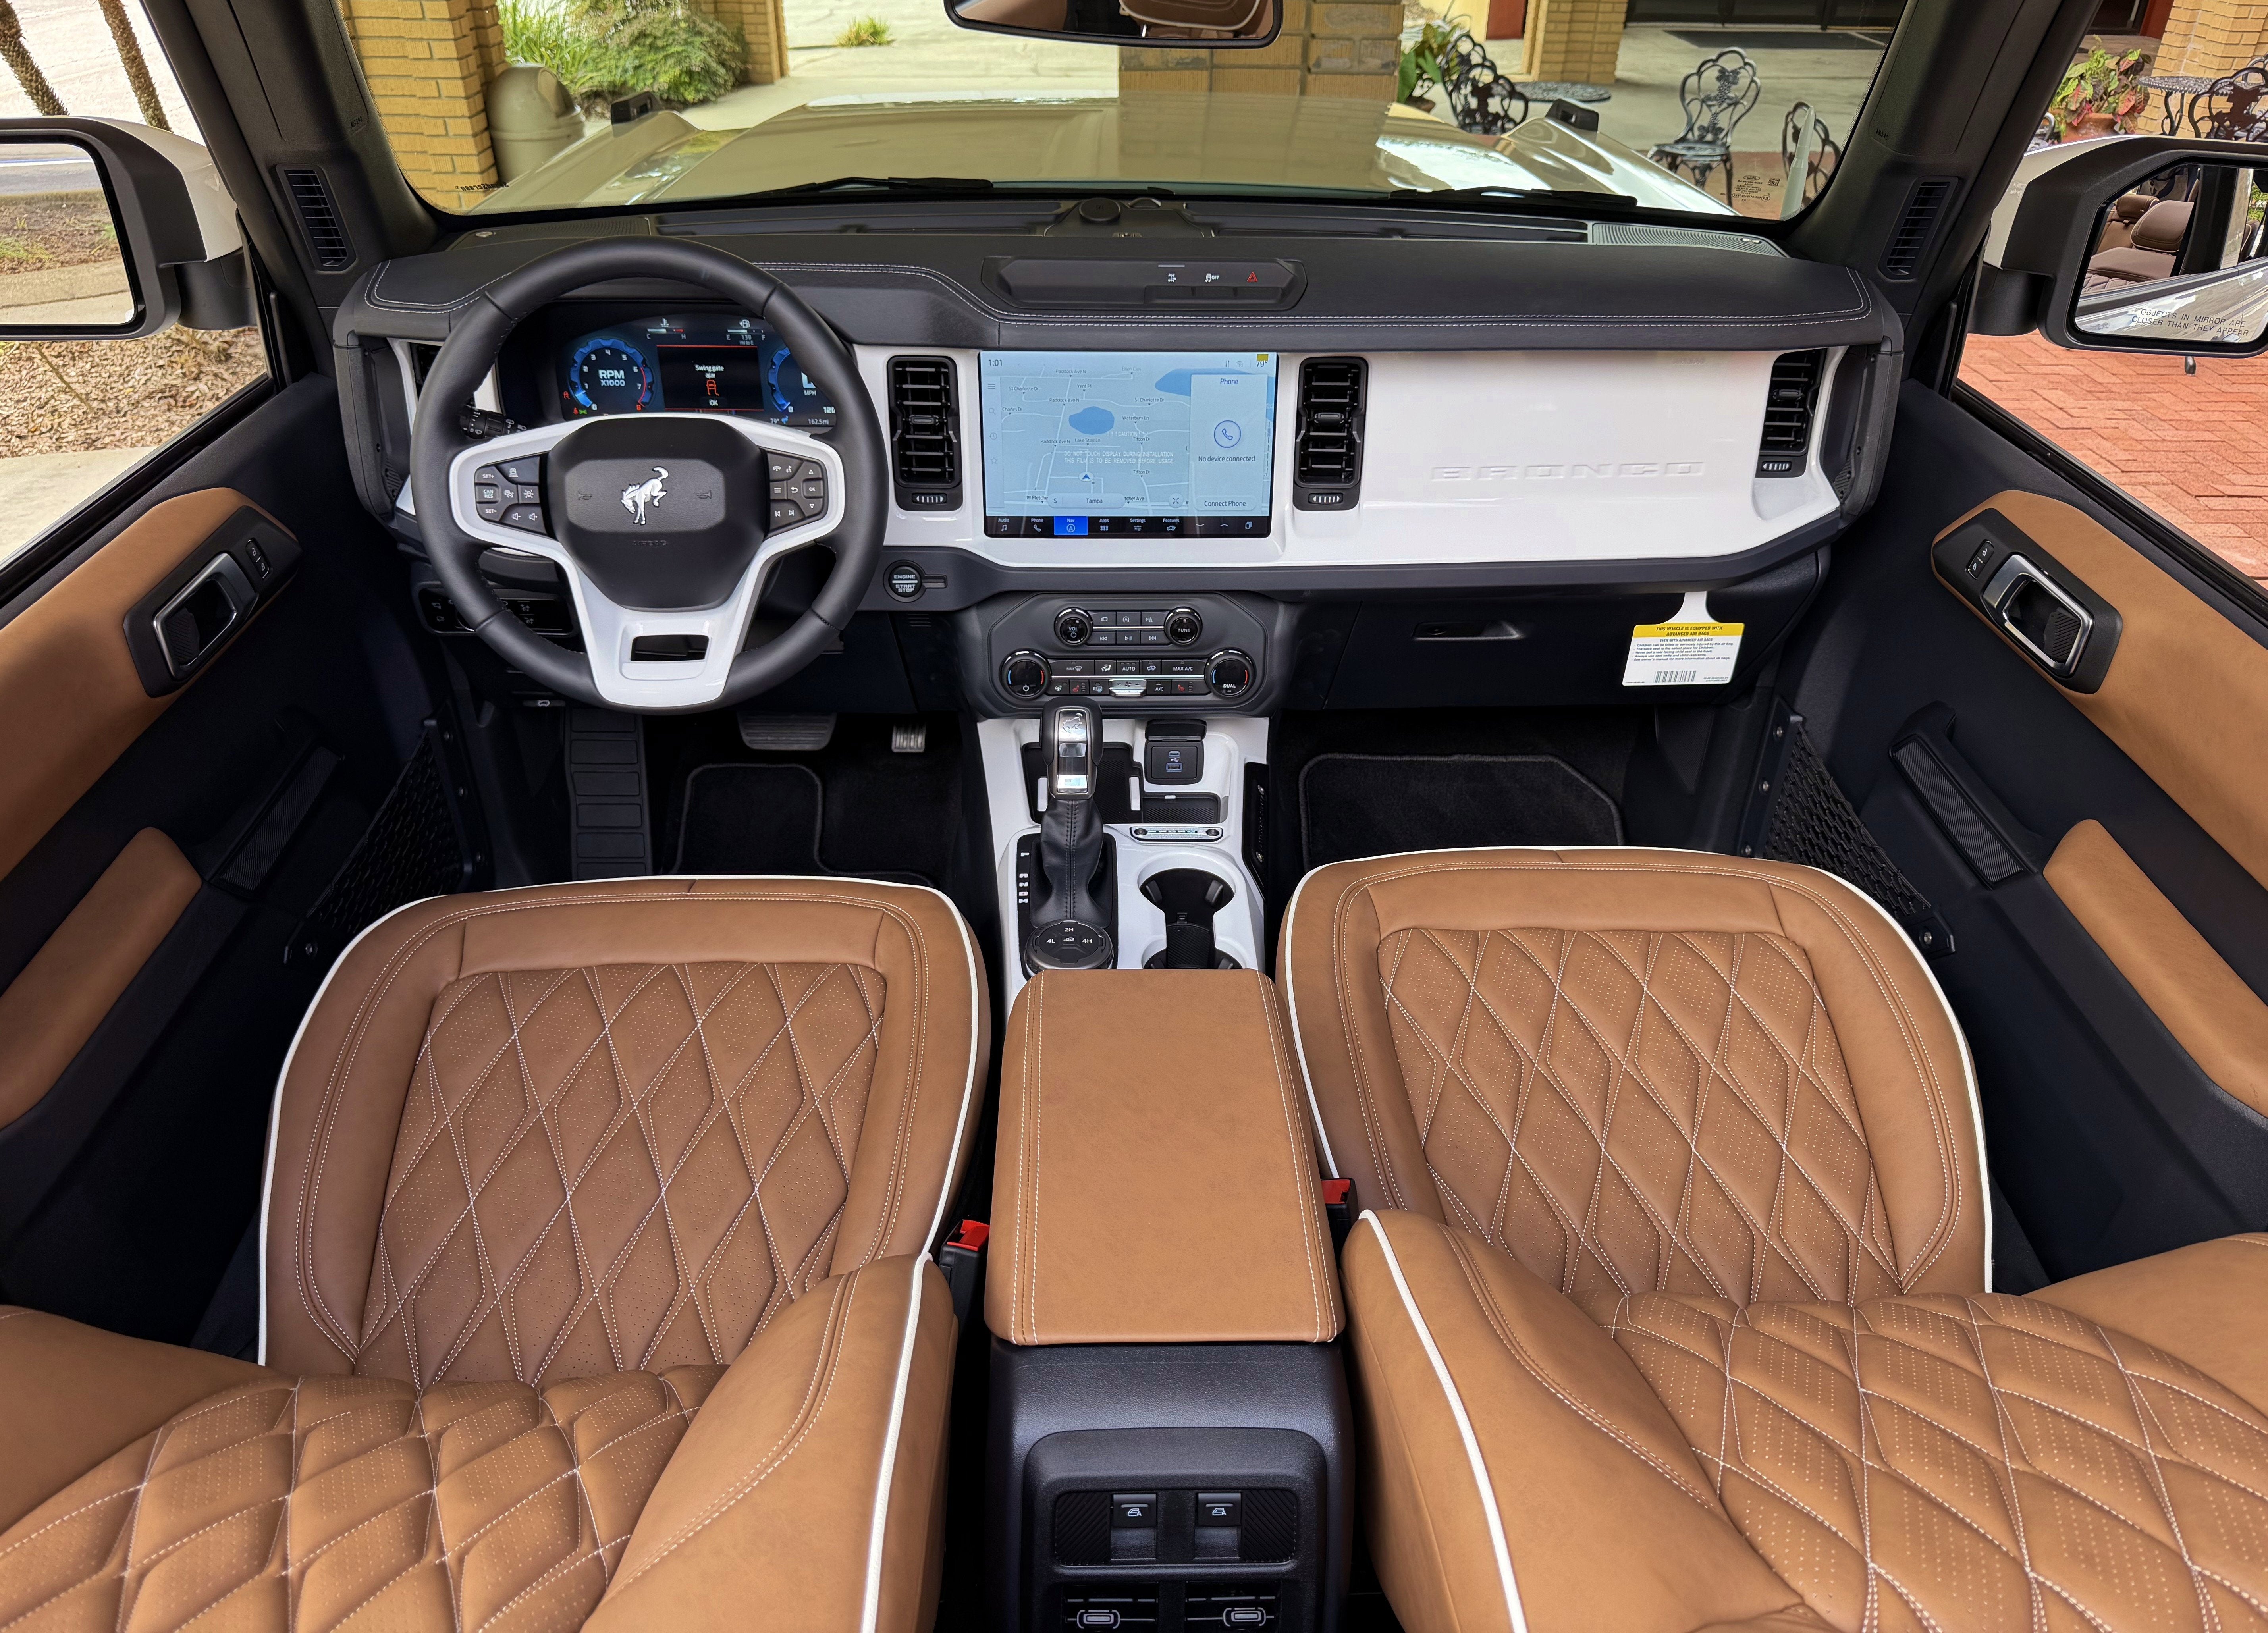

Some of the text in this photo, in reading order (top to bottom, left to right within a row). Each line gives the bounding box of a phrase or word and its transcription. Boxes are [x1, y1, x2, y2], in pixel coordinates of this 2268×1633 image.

[2132, 316, 2249, 337] CLOSER THAN THEY APPEAR
[2141, 308, 2177, 319] OBJECTS
[2193, 315, 2227, 325] MIRROR
[2229, 319, 2246, 328] ARE
[598, 370, 625, 379] RPM
[1431, 461, 1704, 481] BRONCO
